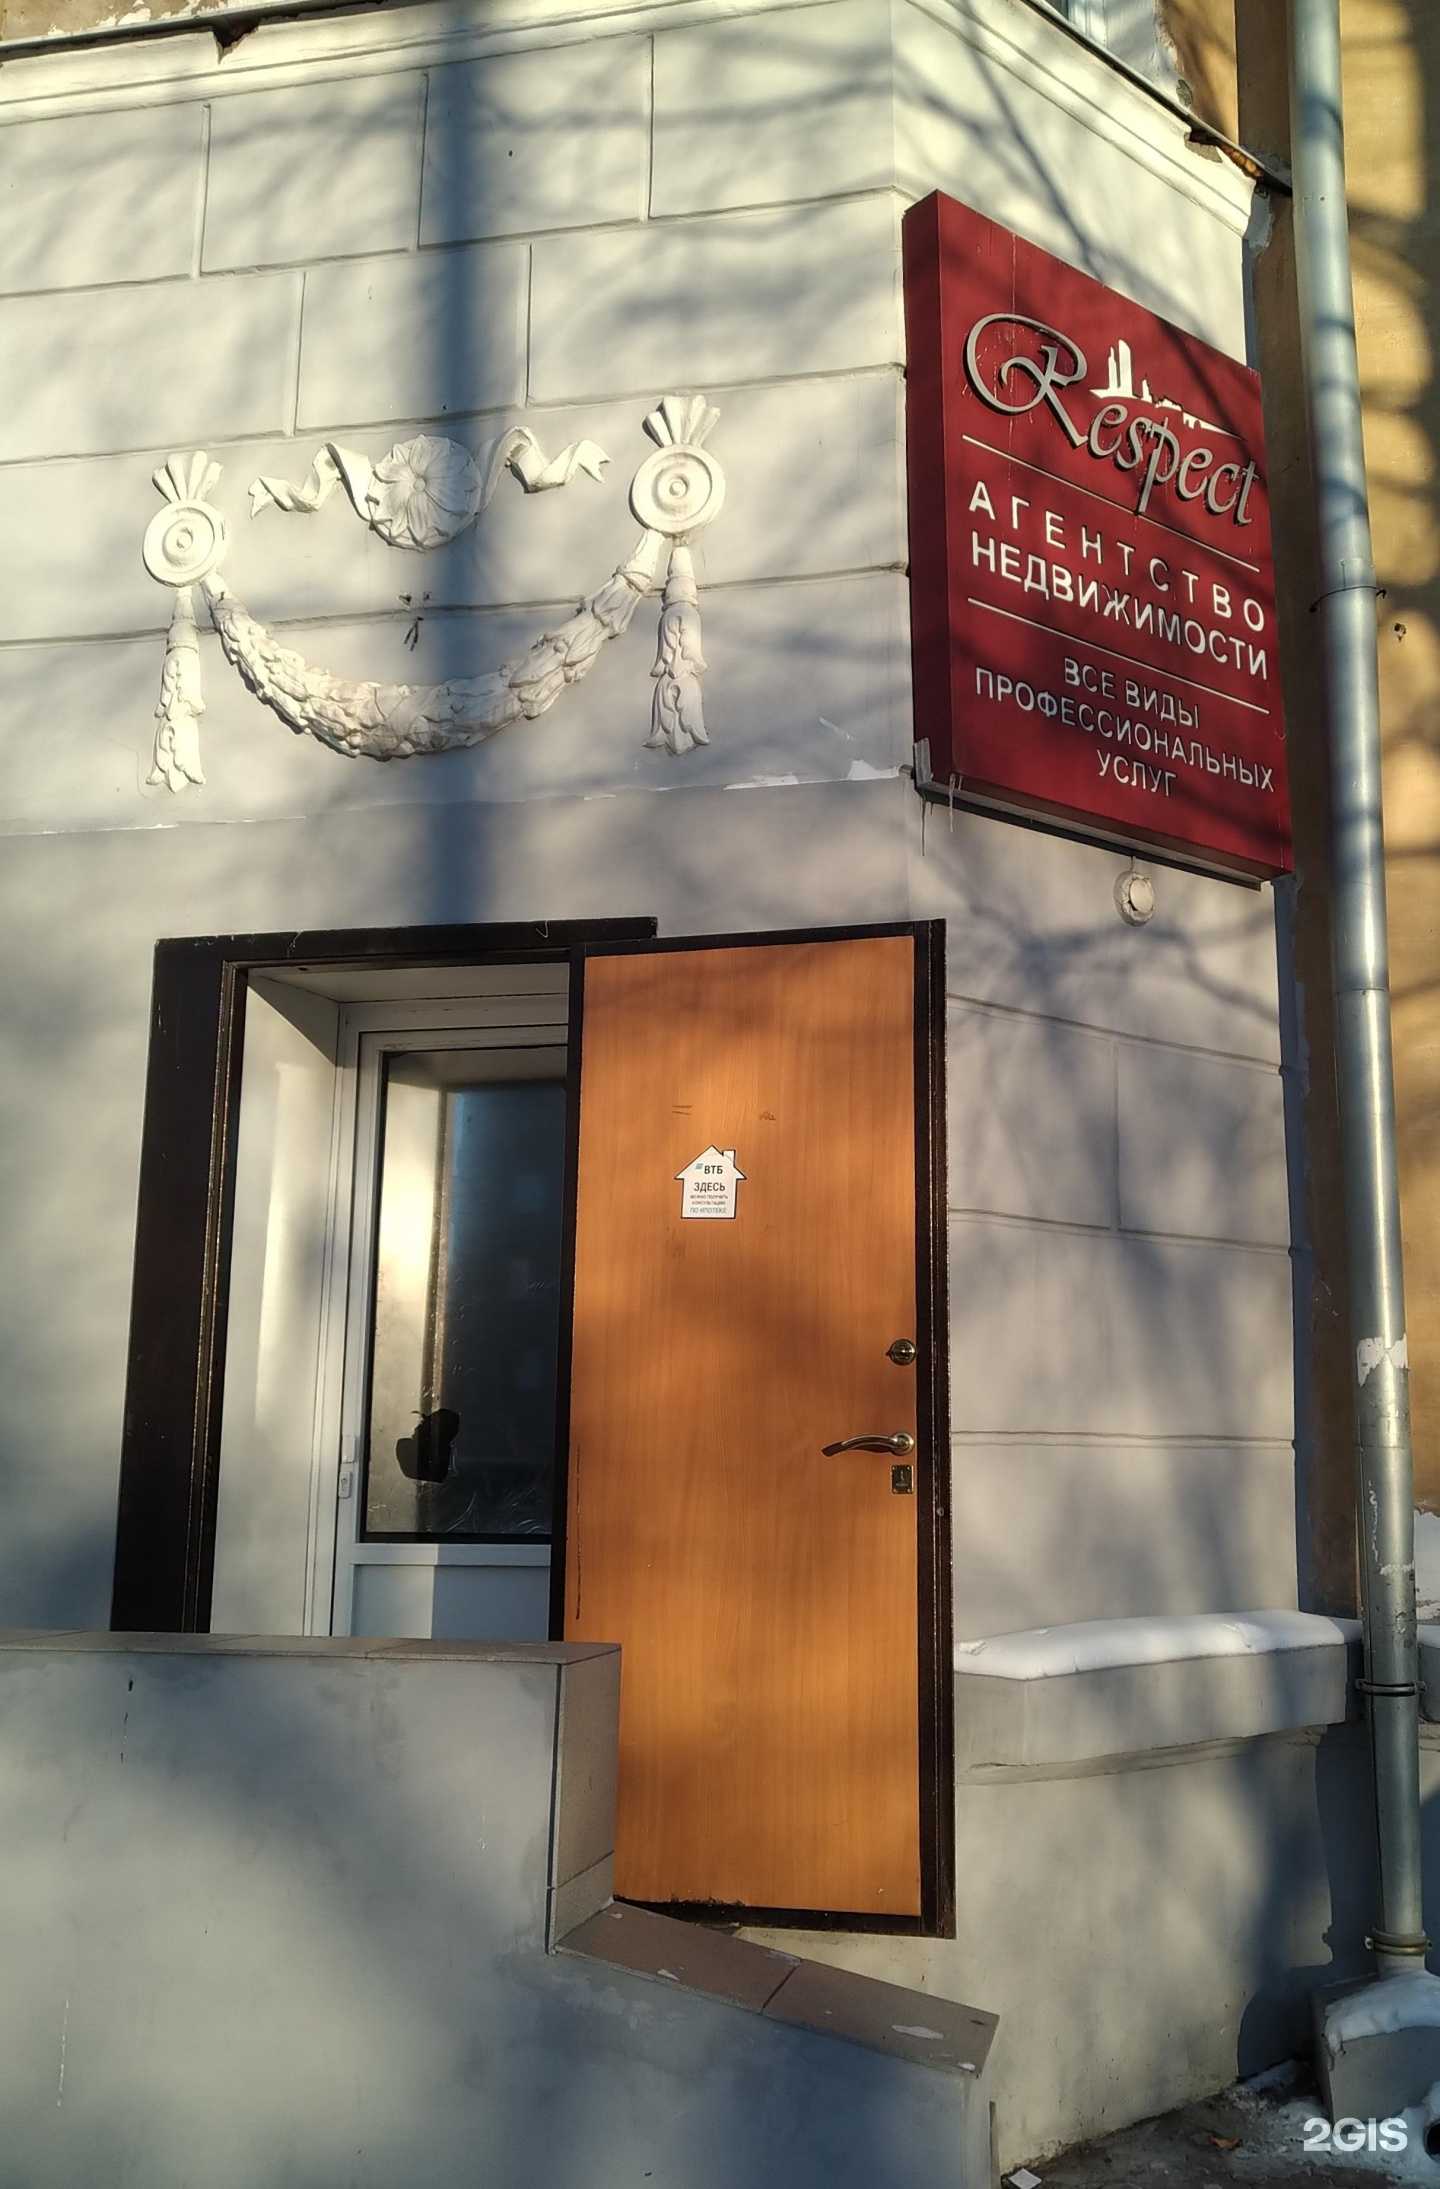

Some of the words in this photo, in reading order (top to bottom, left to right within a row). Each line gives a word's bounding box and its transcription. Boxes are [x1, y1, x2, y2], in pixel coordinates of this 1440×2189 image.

[965, 313, 1261, 525] Respect
[969, 481, 1265, 632] АГЕНТСТВО
[971, 531, 1268, 681] НЕДВИЖИМОСТИ
[975, 667, 1275, 793] ПРОФЕССИОНАЛЬНЫХ
[1064, 658, 1116, 699] ВСЕ
[1125, 680, 1199, 729] ВИДЫ
[1097, 750, 1176, 796] УСЛУГ
[694, 1182, 726, 1193] ЗДЕСЬ
[704, 1165, 723, 1175] ВТБ
